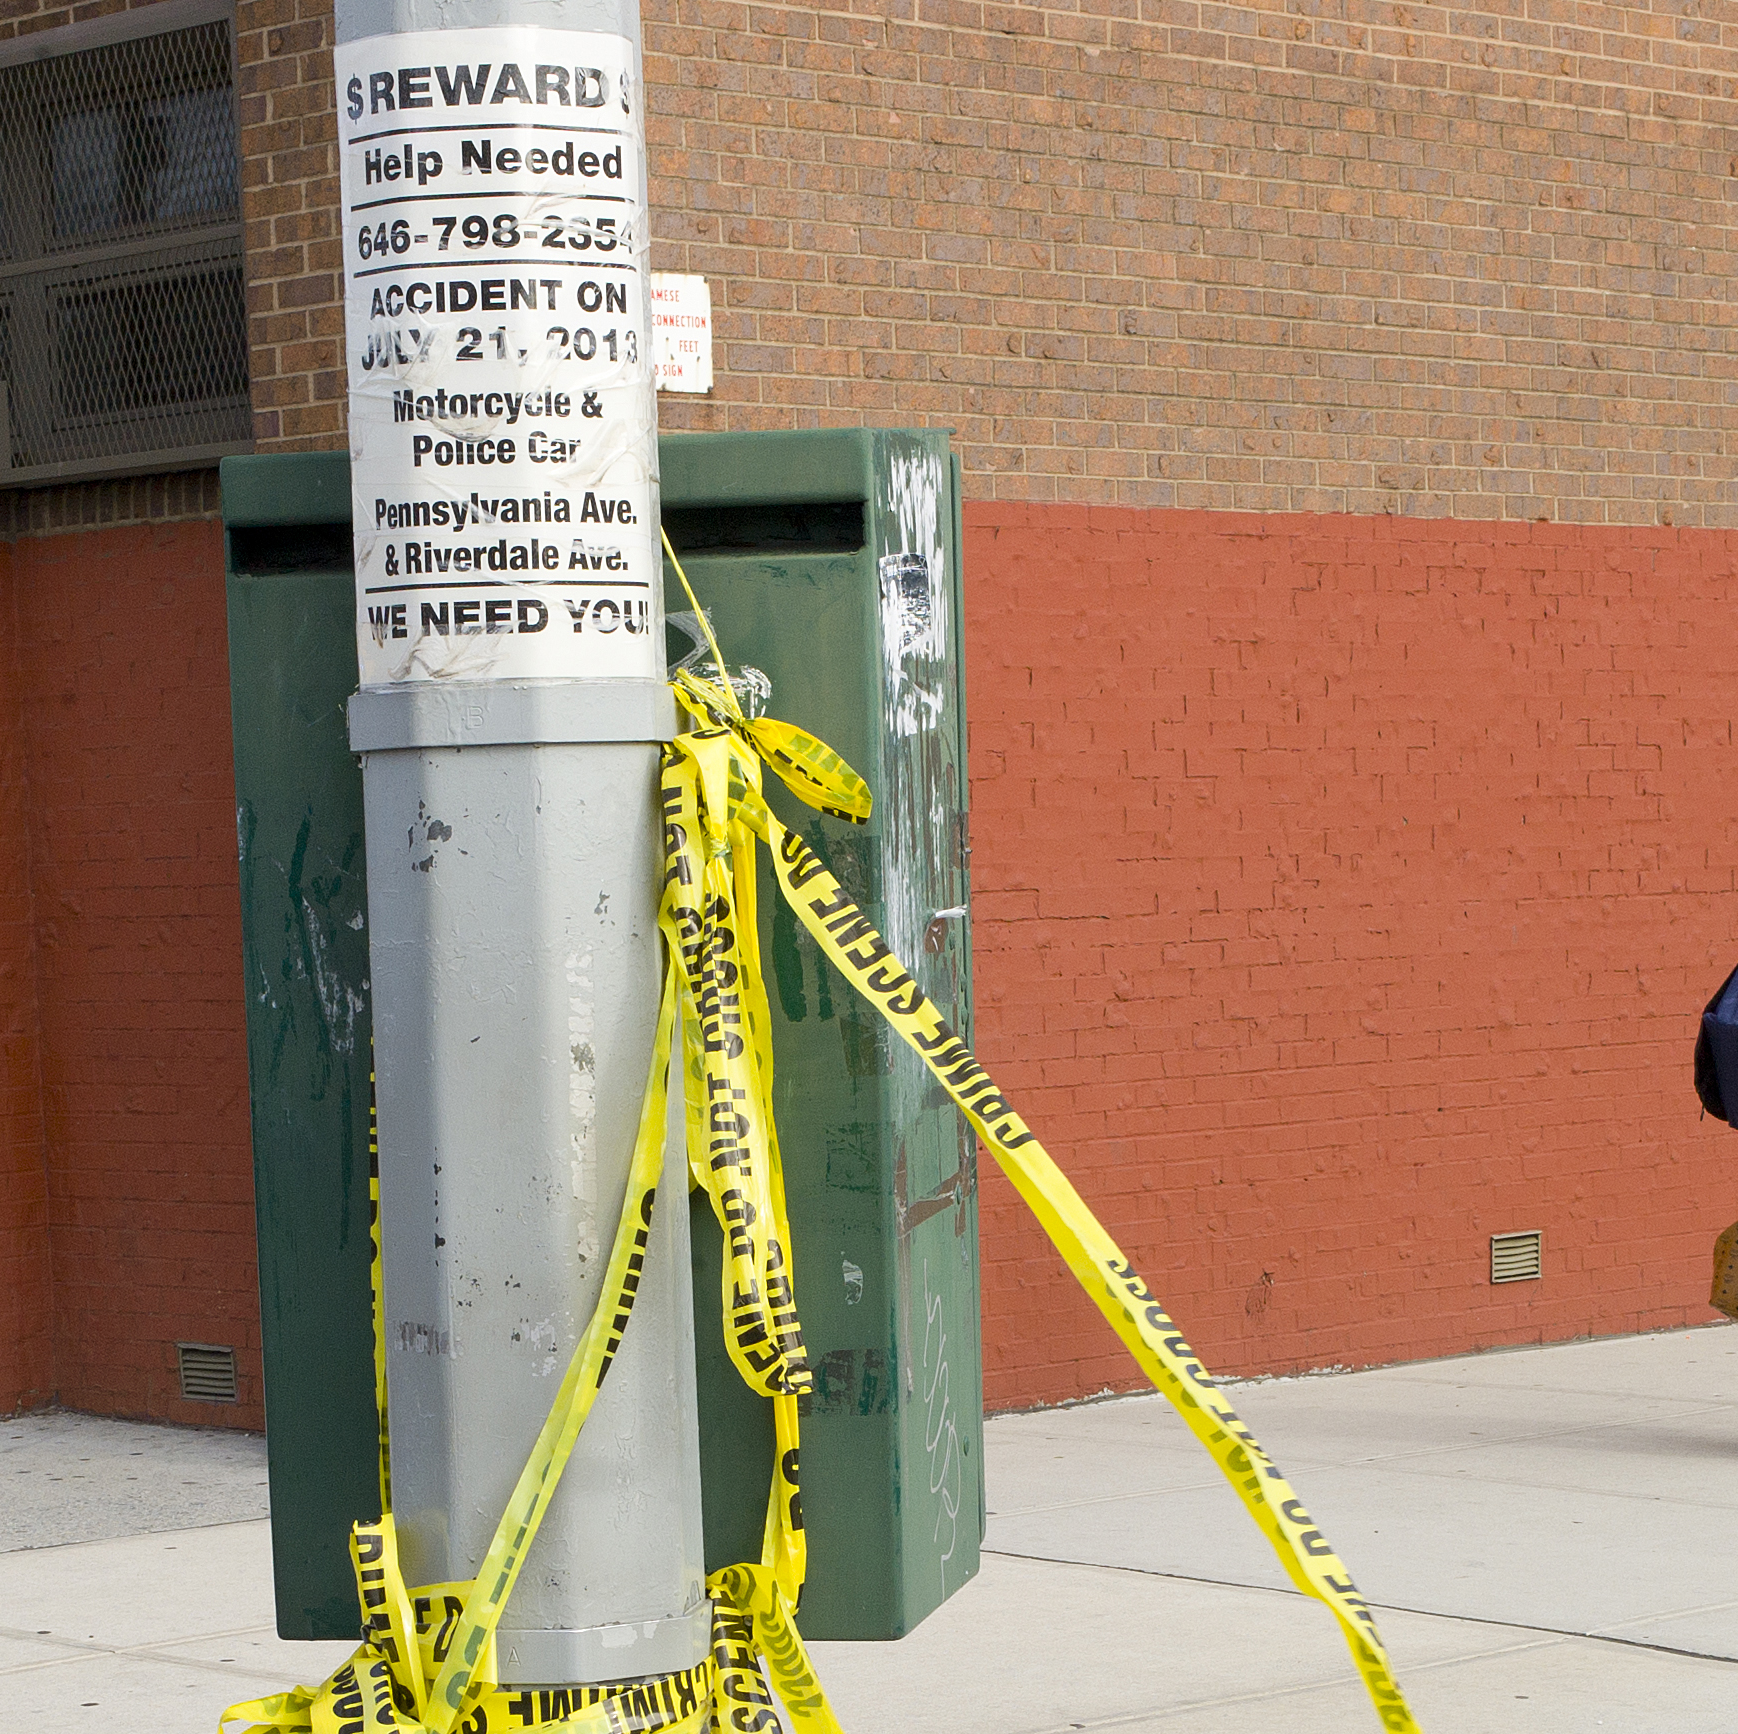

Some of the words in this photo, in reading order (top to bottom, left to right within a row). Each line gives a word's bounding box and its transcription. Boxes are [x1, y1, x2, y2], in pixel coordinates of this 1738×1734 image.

[364, 143, 444, 186] Help
[461, 139, 623, 180] Needed
[369, 278, 563, 321] ACCIDENT
[576, 280, 628, 315] ON
[650, 288, 680, 303] AMESE
[361, 327, 431, 371] JULY
[546, 326, 638, 366] 2013
[679, 340, 700, 353] FEET
[663, 364, 684, 377] SIGN
[393, 385, 571, 425] Motorcycle
[581, 389, 604, 419] &
[412, 435, 516, 468] Police
[528, 430, 582, 464] Car
[374, 490, 571, 532] Pennsylvania
[580, 491, 638, 525] Ave.
[384, 543, 400, 577] &
[405, 538, 560, 574] Riverdale
[568, 538, 629, 572] Ave.
[368, 605, 408, 641] WE
[421, 599, 549, 638] NEED
[808, 888, 926, 1015] SCENE
[911, 1020, 1037, 1150] CRIME
